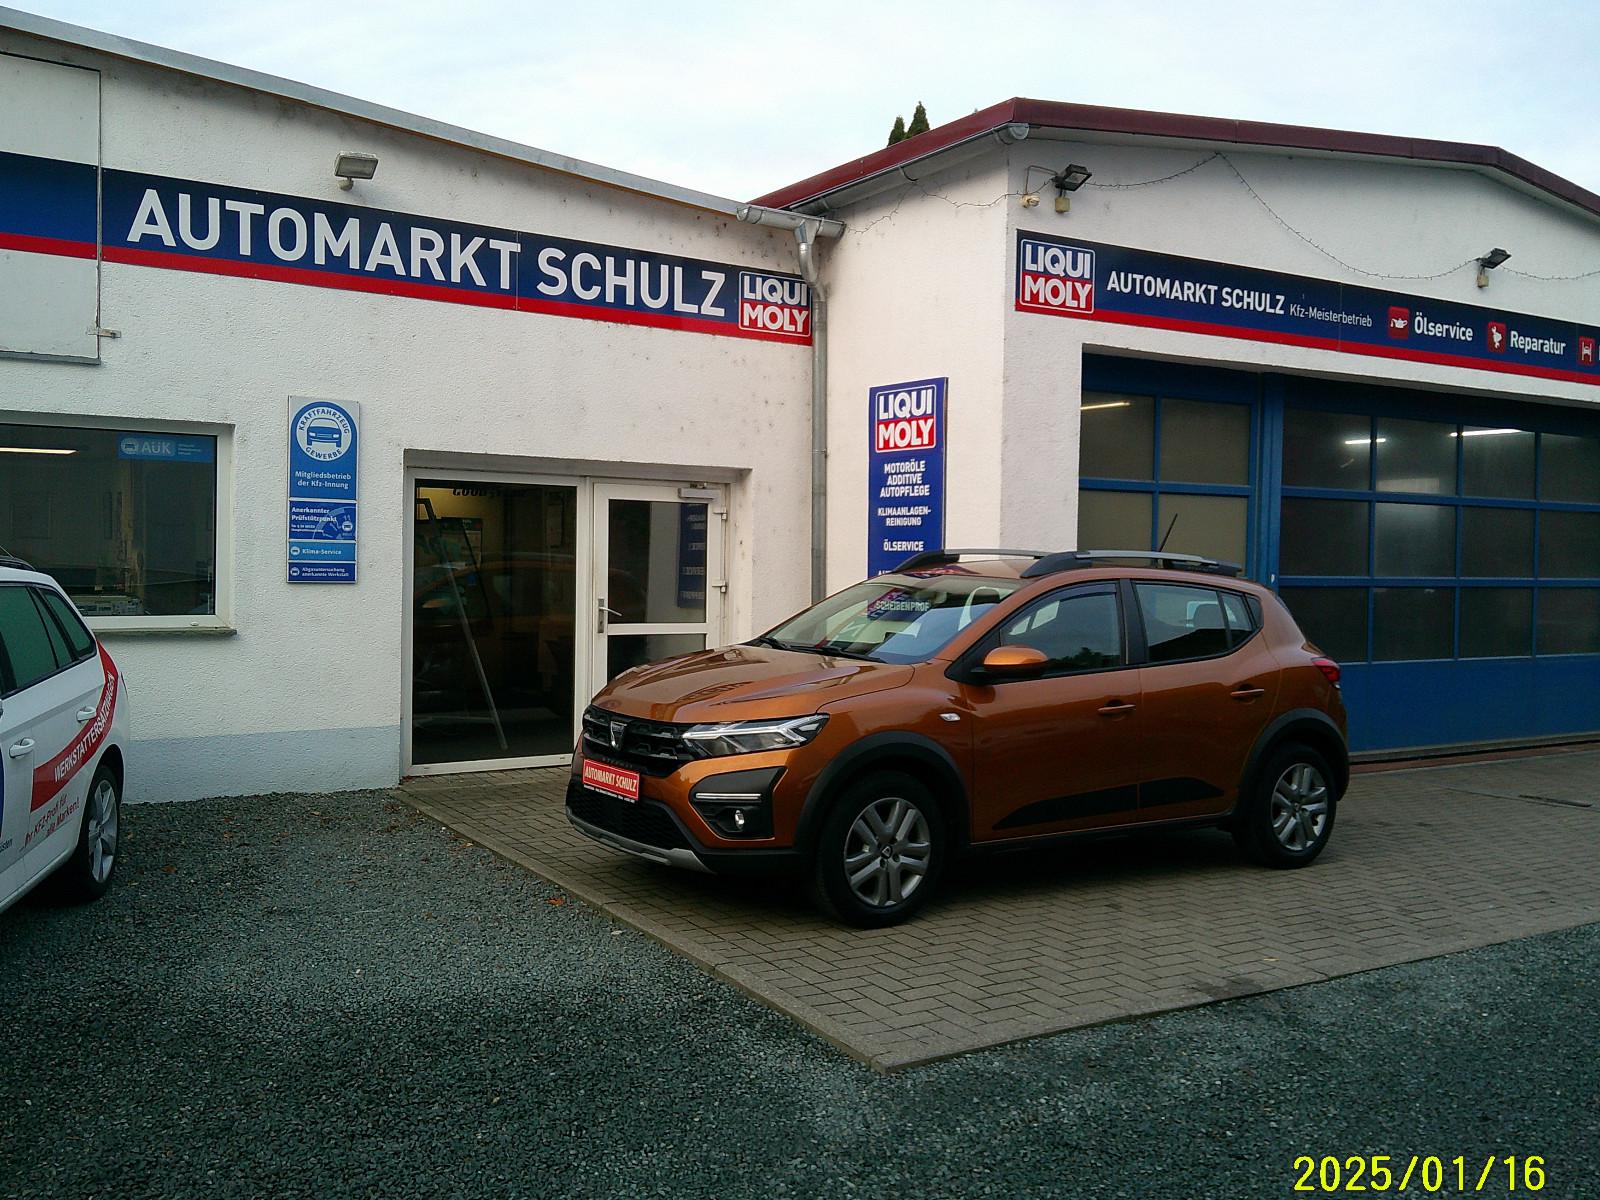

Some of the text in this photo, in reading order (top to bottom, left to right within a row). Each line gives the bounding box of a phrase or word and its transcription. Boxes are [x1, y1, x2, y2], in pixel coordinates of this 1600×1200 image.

[126, 189, 727, 317] AUTOMARKT SCHULZ
[1025, 244, 1091, 279] LIQUI
[743, 275, 808, 306] LIQUI
[1024, 275, 1093, 309] MOLY
[743, 303, 809, 332] MOLY
[1106, 270, 1567, 355] AUTOMARKT SCHULZ Kfz-Meisterbetrieb Ölservice Reparatur
[878, 388, 933, 420] LIQUI
[298, 408, 350, 434] KRAFTFAHRZEUG
[878, 418, 934, 449] MOLY
[305, 446, 342, 459] GEWERBE
[295, 471, 352, 480] Mitgliedsbetrieb
[884, 459, 926, 474] MOTORÖLE
[887, 473, 922, 486] ADDITIVE
[311, 481, 349, 490] Kfz-Innung
[880, 485, 930, 498] AUTOPFLEGE
[877, 506, 932, 517] KLIMAANLAGEN-
[885, 516, 922, 527] REINIGUNG
[883, 538, 924, 552] ÖLSERVICE
[585, 764, 637, 792] AUTOMARKT SCHULZ
